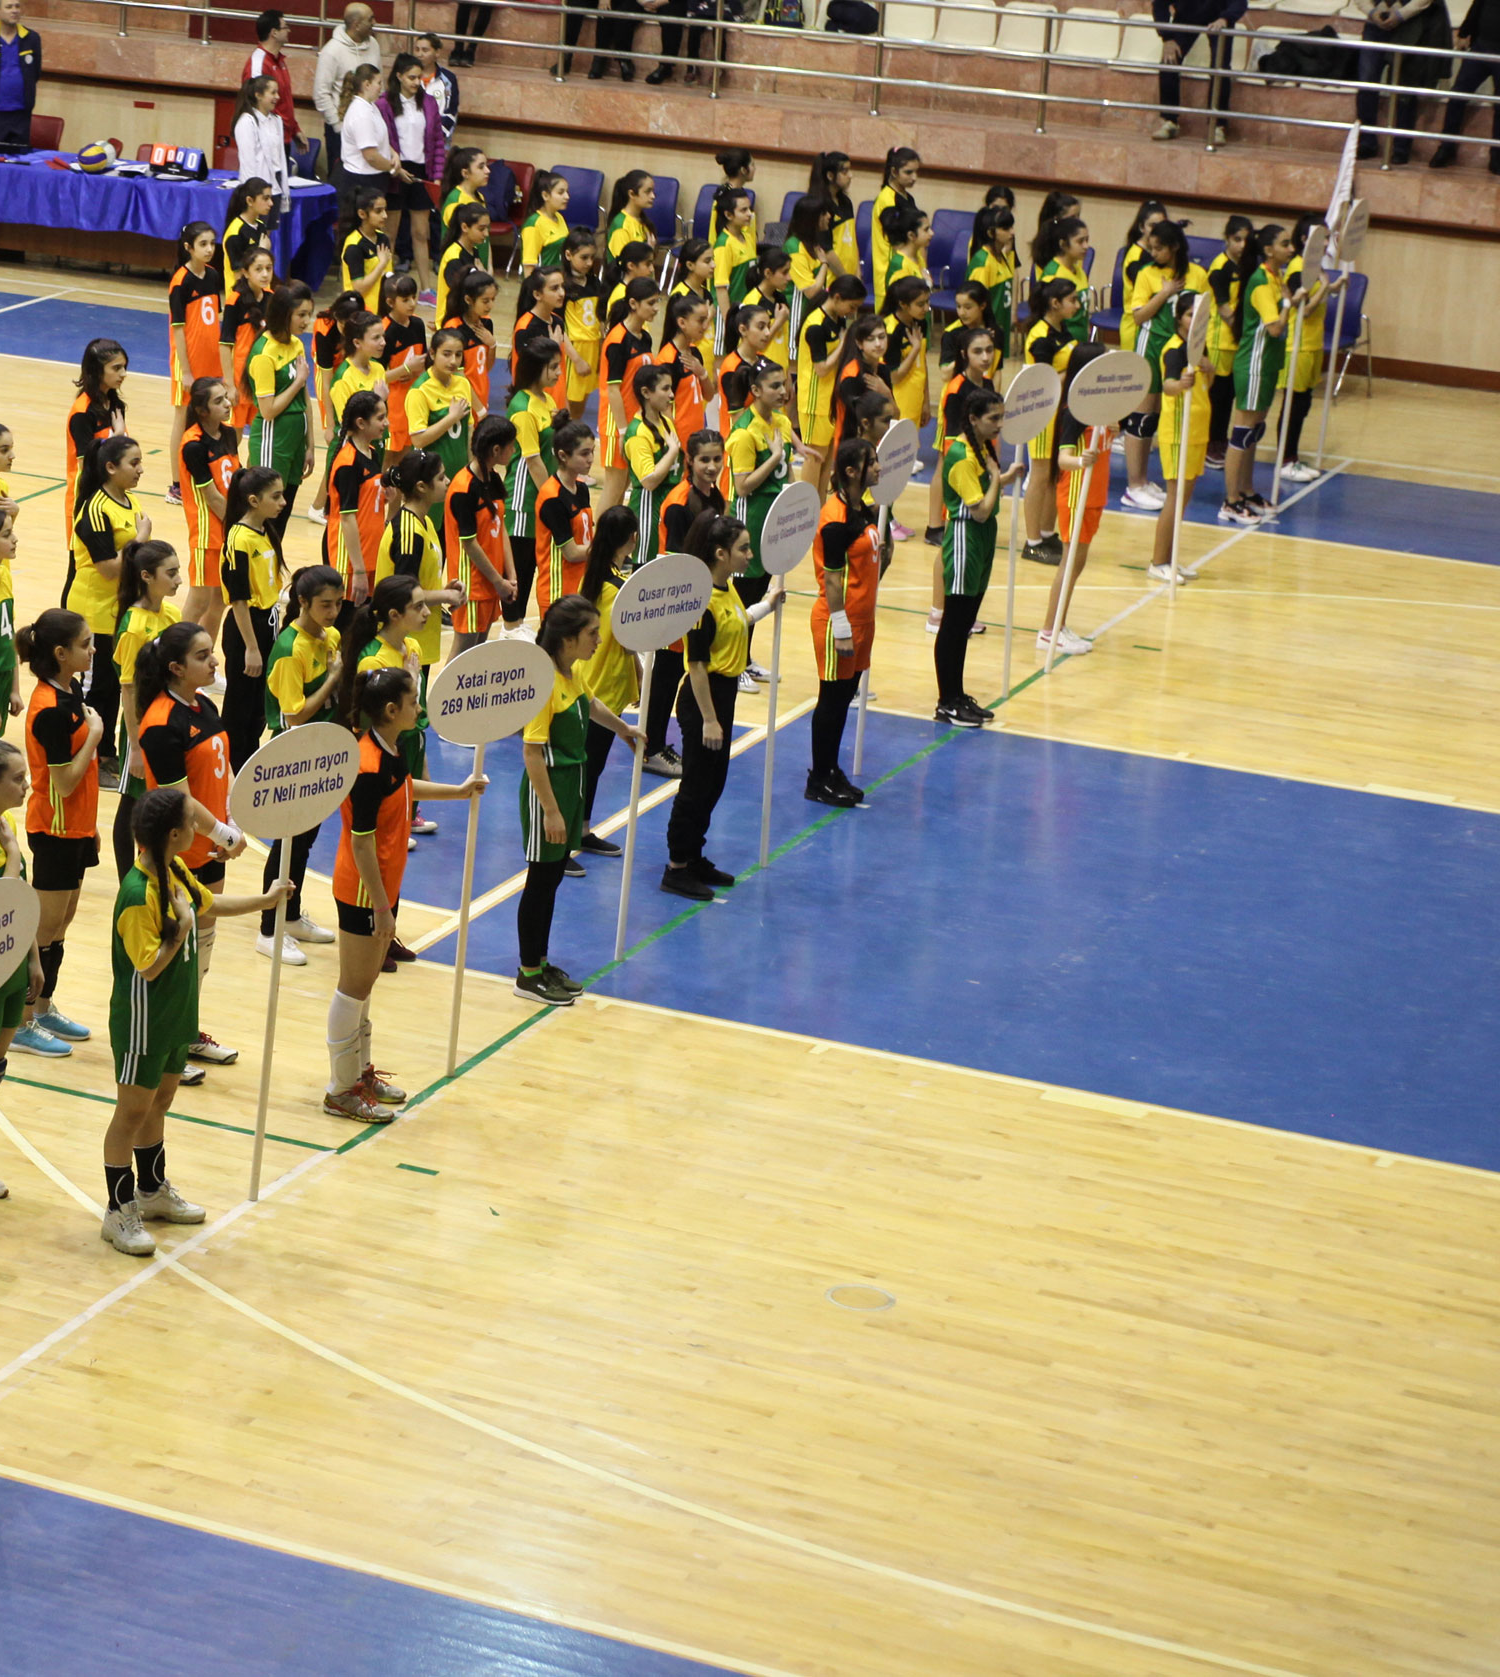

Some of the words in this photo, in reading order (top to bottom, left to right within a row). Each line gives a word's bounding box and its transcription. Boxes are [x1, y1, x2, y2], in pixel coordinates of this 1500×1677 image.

[153, 147, 164, 164] 0
[167, 150, 175, 161] 0
[176, 151, 184, 163] 0
[186, 153, 197, 169] 0
[201, 296, 216, 326] 6
[583, 299, 596, 326] 8
[262, 549, 276, 587] 7
[638, 587, 665, 603] Qusar
[667, 583, 692, 599] rayon
[0, 602, 13, 641] 4
[620, 610, 642, 625] Urva
[643, 604, 666, 620] kənd
[667, 597, 702, 615] məktəbi
[455, 670, 488, 691] Xətai
[490, 667, 525, 686] rayon
[440, 697, 463, 716] 269
[491, 684, 535, 706] məktəb
[211, 736, 226, 780] 3
[253, 759, 312, 783] Suraxanı
[314, 750, 349, 772] rayon
[252, 788, 270, 808] 87
[299, 773, 344, 799] məktəb
